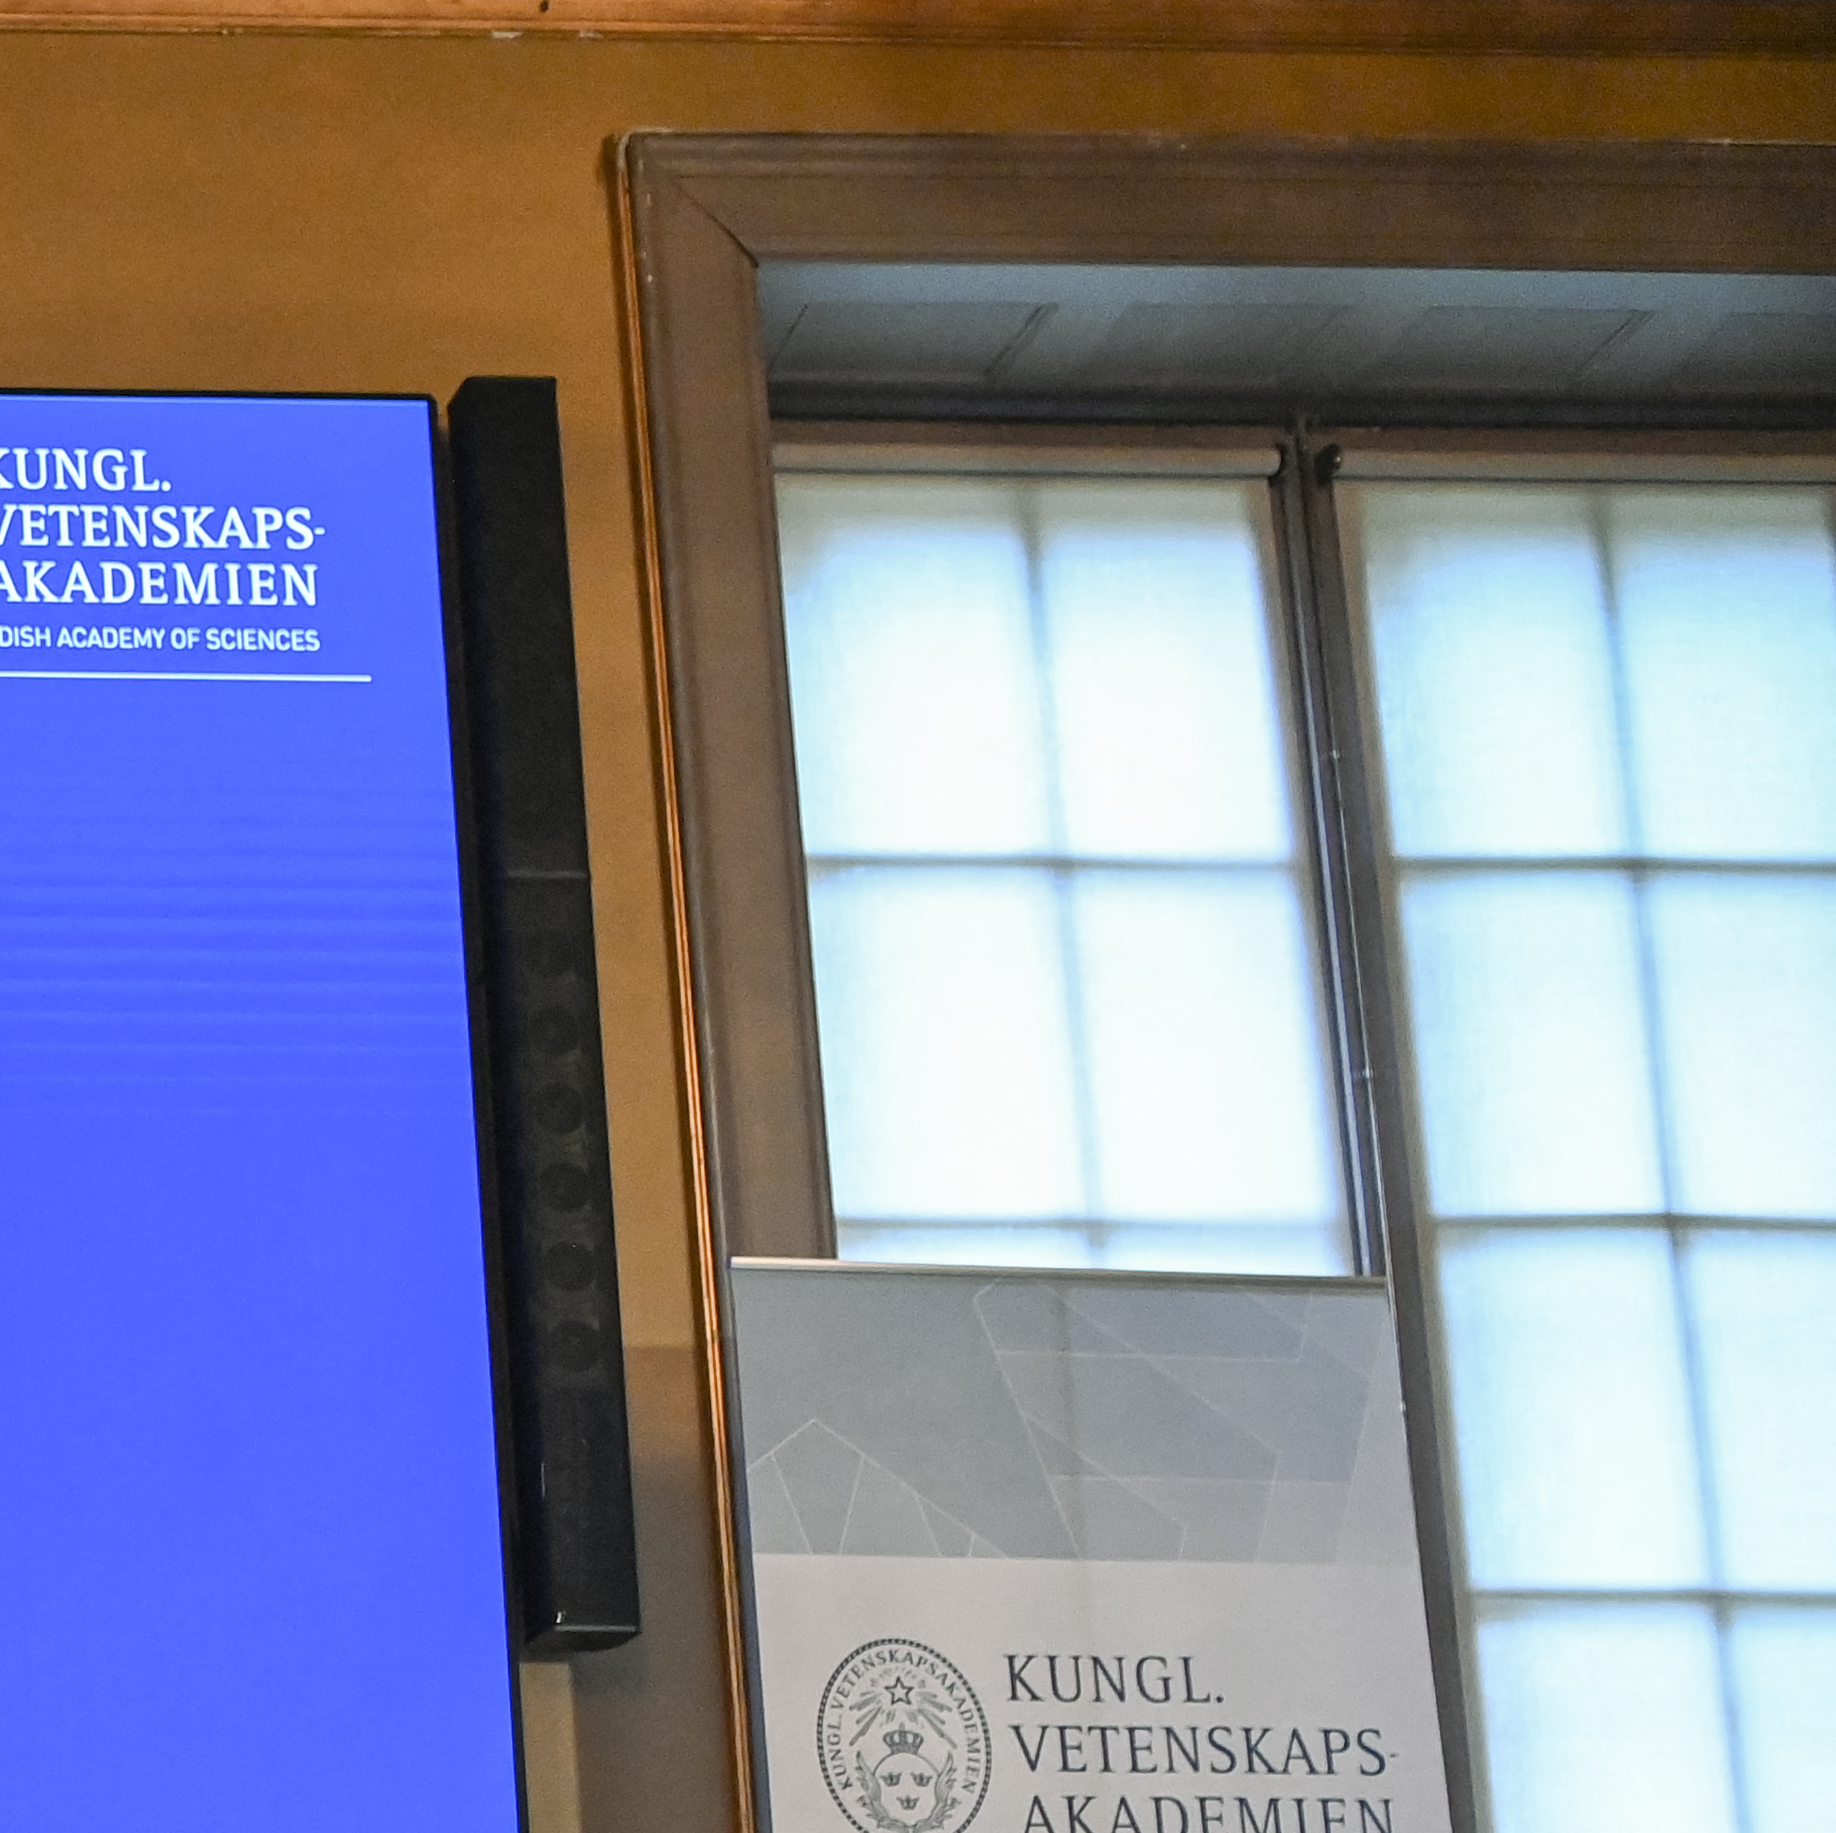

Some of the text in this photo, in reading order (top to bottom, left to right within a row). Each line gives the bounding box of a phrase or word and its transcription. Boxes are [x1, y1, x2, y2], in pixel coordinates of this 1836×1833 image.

[57, 627, 165, 649] ACADEMY
[170, 628, 200, 649] OF
[206, 628, 321, 651] SCIENCES
[1006, 1654, 1224, 1704] KUNGL.
[1010, 1724, 1396, 1777] VETENSKAPS-
